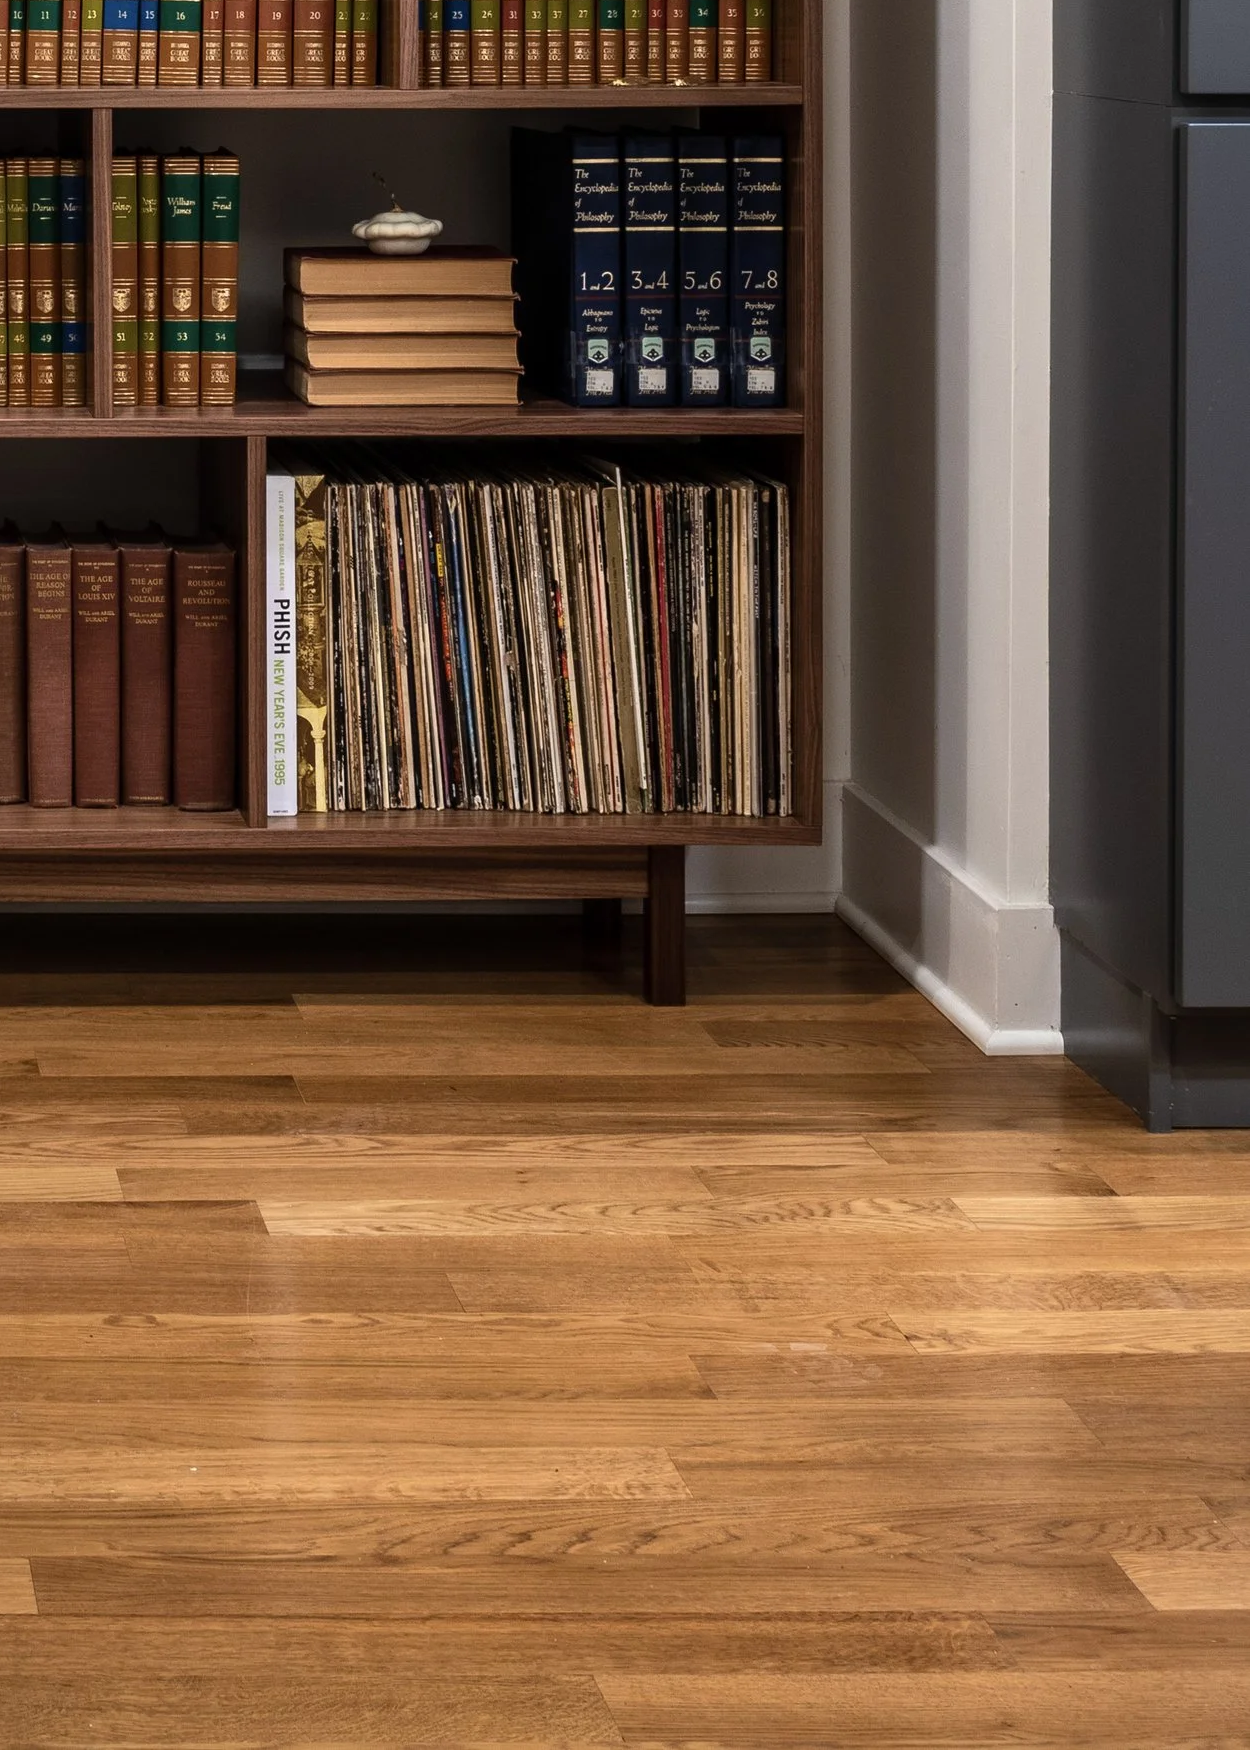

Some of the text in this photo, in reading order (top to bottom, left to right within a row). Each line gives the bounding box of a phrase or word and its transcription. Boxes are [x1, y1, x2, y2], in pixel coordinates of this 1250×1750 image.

[41, 11, 49, 20] 11
[117, 10, 127, 19] 14
[176, 11, 185, 21] 16
[309, 11, 320, 20] 20
[481, 10, 493, 18] 26
[697, 8, 709, 17] 34
[575, 168, 589, 179] The
[628, 167, 643, 178] The
[680, 168, 694, 178] The
[737, 168, 751, 178] The
[575, 183, 619, 194] Encyclopedia
[628, 182, 673, 193] Encyclopedia
[680, 182, 724, 194] Encyclopedia
[737, 181, 781, 193] Encyclopedia
[167, 196, 196, 206] William
[212, 201, 232, 210] Freud
[575, 198, 582, 208] of
[628, 197, 635, 207] of
[680, 198, 686, 208] of
[737, 197, 743, 207] of
[171, 205, 192, 217] James
[737, 210, 777, 222] Philosophy
[574, 211, 614, 223] Philosophy
[628, 210, 668, 223] Philosophy
[680, 211, 720, 223] Philosophy
[580, 271, 587, 290] 1
[601, 271, 615, 290] 2
[631, 270, 643, 290] 3
[657, 270, 669, 289] 4
[684, 271, 696, 290] 5
[709, 270, 722, 290] 6
[741, 270, 753, 290] 7
[766, 270, 778, 289] 8
[215, 332, 227, 341] 54
[91, 584, 102, 592] OF
[274, 599, 291, 786] PHISH NEW YEAR'S EVE 1995
